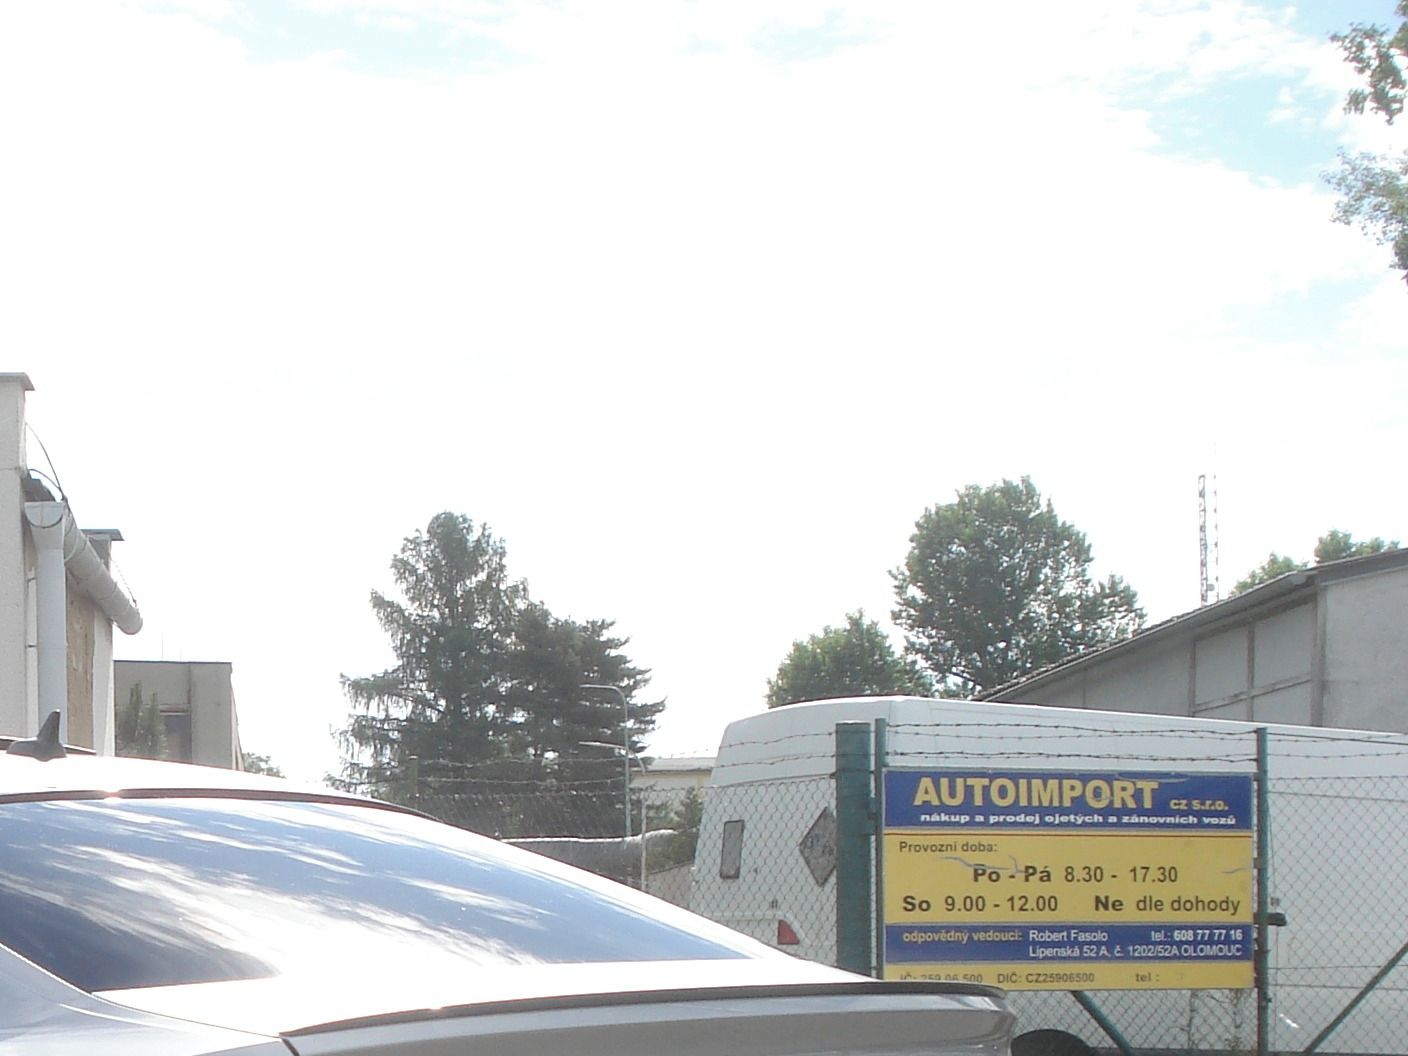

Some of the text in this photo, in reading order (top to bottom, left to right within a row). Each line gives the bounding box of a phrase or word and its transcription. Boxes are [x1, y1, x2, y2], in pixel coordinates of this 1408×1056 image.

[913, 776, 1159, 809] AUTOIMPORT
[1192, 798, 1229, 811] s.r.o.
[920, 812, 970, 823] nákup
[975, 814, 985, 822] a
[989, 813, 1040, 825] prodej
[1044, 813, 1103, 826] ojetých
[1122, 814, 1198, 825] zánovních
[1203, 814, 1237, 825] vozů
[899, 841, 998, 853] Provozní doba:
[973, 864, 1001, 883] Po
[1024, 865, 1052, 883] Pá
[1064, 866, 1104, 883] 8.30
[1129, 866, 1178, 883] 17.30
[902, 895, 932, 912] So
[944, 895, 986, 912] 9.00
[1007, 895, 1059, 912] 12.00
[1094, 895, 1124, 912] Ne
[1136, 895, 1164, 912] dle
[1170, 895, 1241, 916] dohody
[903, 930, 969, 944] odpovědný
[1029, 930, 1068, 942] Robert
[1071, 930, 1109, 942] Fasolo
[1151, 930, 1171, 942] tel.:
[1173, 930, 1194, 941] 608
[1196, 930, 1210, 941] 77
[1213, 930, 1227, 941] 77
[1230, 930, 1243, 941] 16
[1029, 946, 1080, 959] Lipenská
[1083, 945, 1097, 957] 52
[1129, 945, 1179, 957] 1202/52A
[1181, 945, 1243, 957] OLOMOUC
[997, 971, 1022, 983] DIČ:
[1025, 973, 1095, 984] CZ25906500
[1135, 973, 1152, 982] tel
